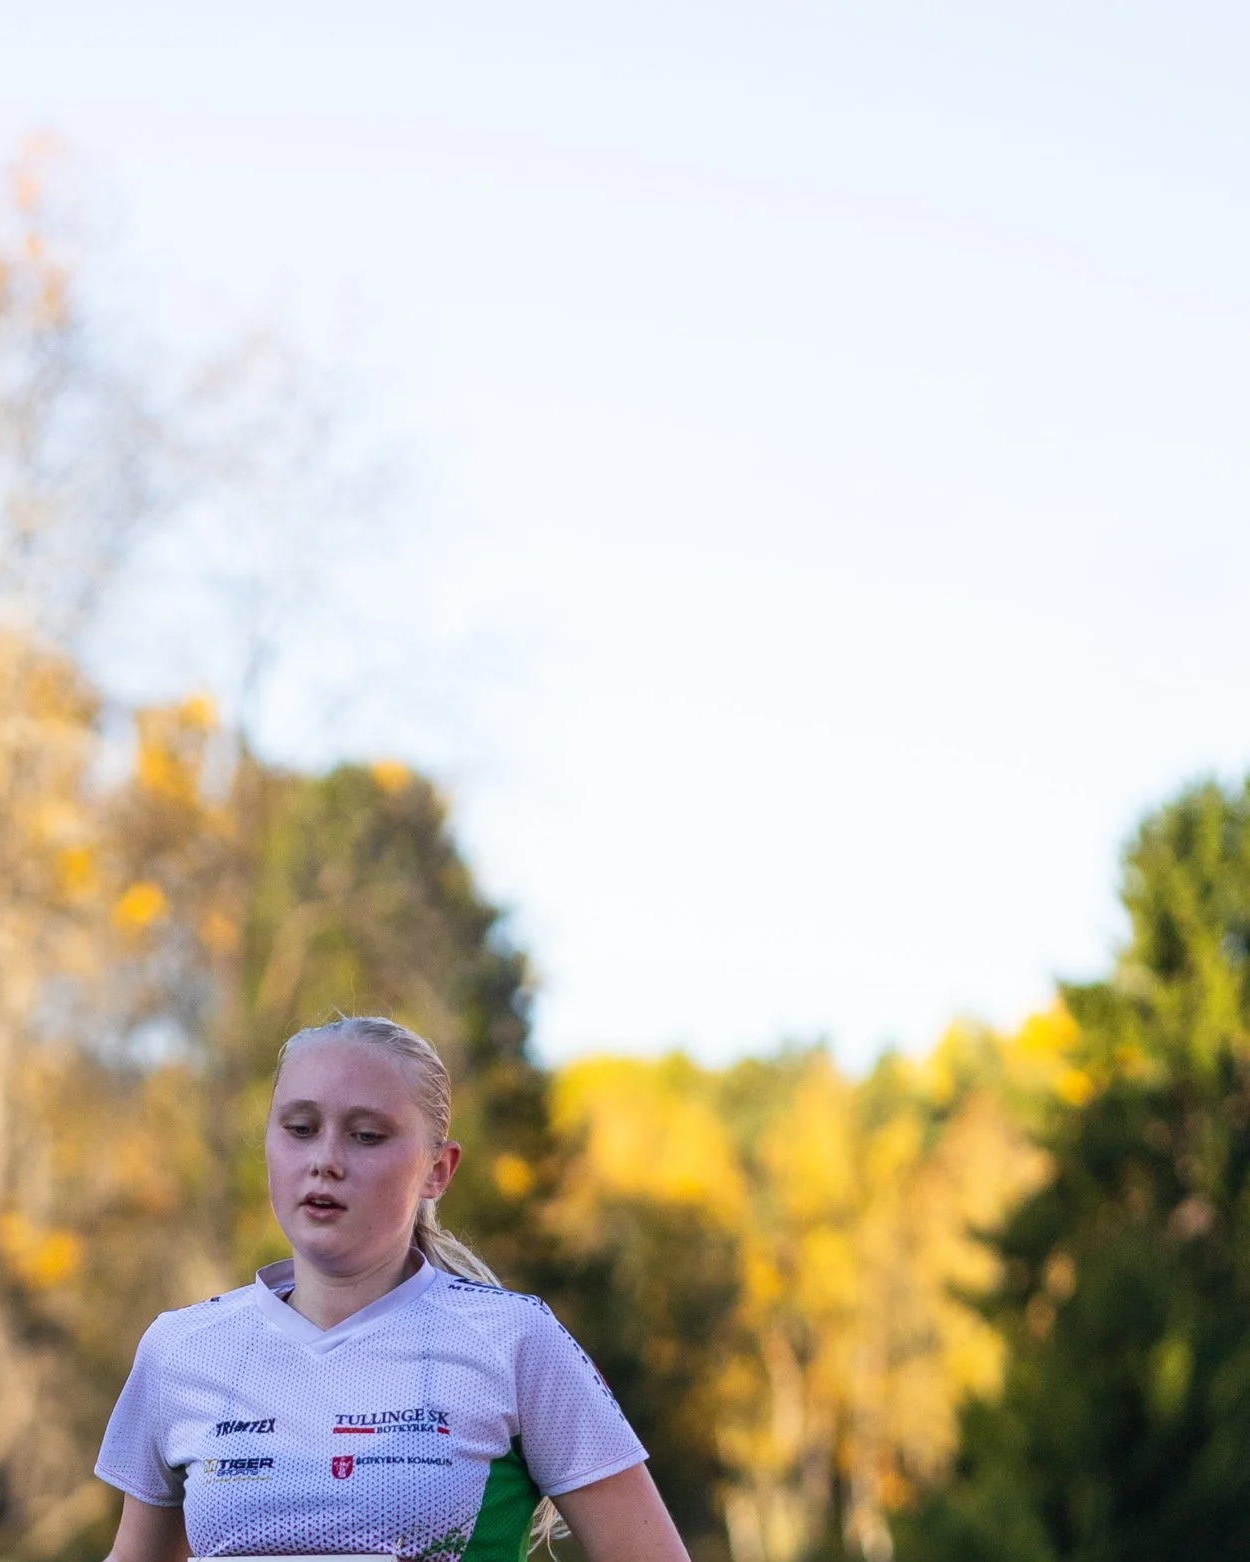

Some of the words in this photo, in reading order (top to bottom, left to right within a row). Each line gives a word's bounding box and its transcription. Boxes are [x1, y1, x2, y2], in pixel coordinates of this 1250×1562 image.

[335, 1409, 425, 1426] TULLINGE
[428, 1410, 450, 1426] SK
[376, 1423, 435, 1434] BOTKYRKA
[219, 1458, 275, 1469] TIGER
[356, 1456, 405, 1465] BOTKYRKA
[407, 1456, 453, 1466] KOMMUN
